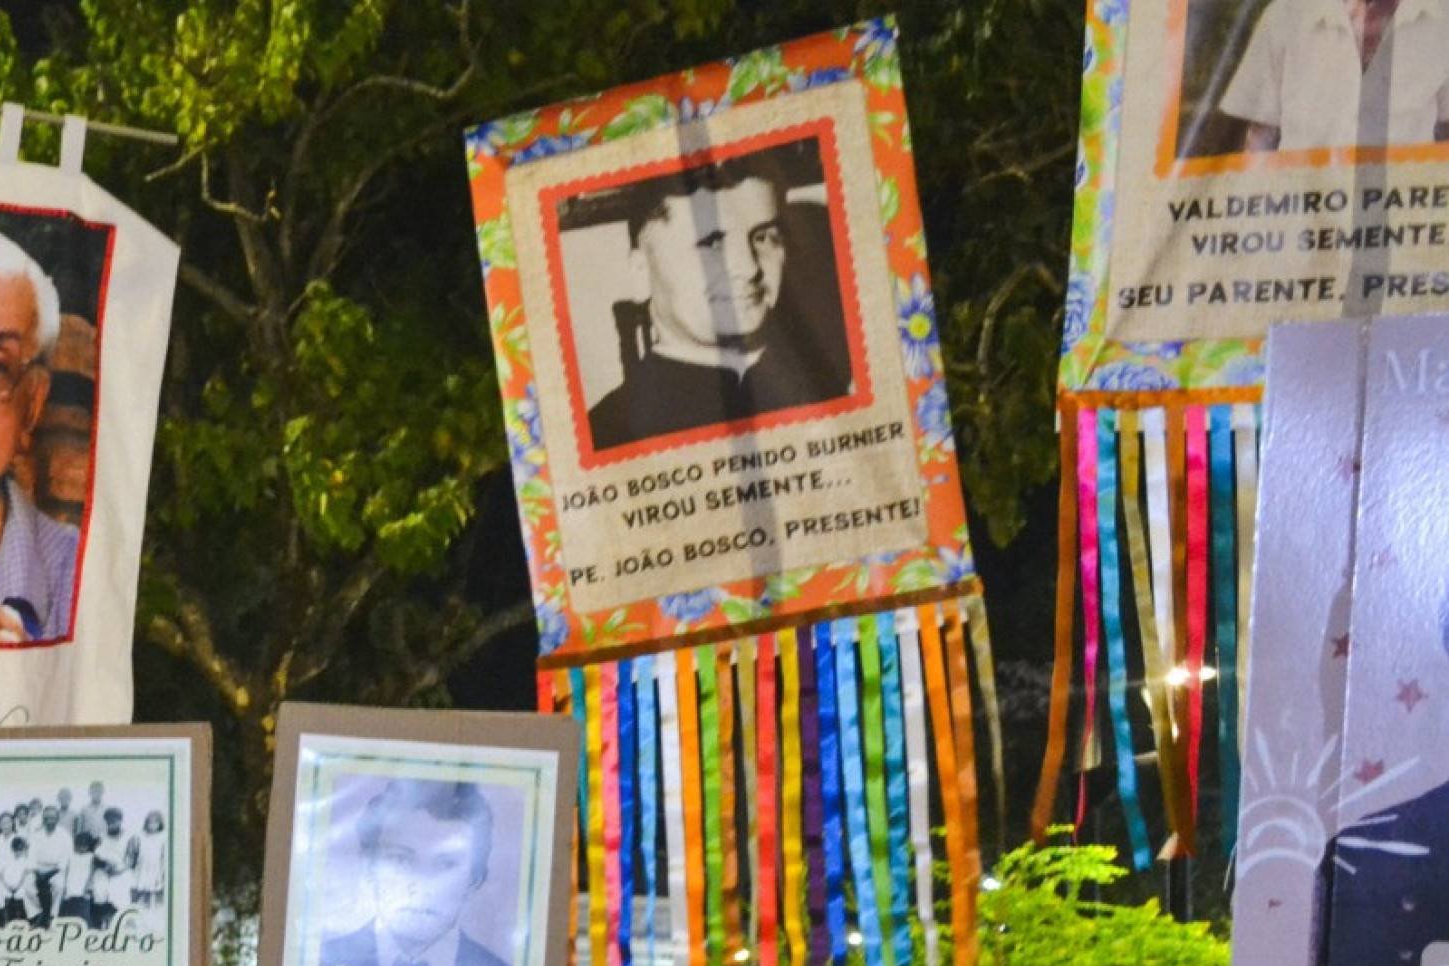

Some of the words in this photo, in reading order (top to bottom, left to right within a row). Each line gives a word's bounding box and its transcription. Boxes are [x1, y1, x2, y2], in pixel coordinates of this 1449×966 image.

[1168, 188, 1348, 222] VALDEMIRO
[1191, 231, 1284, 256] VIROU
[1298, 222, 1447, 251] SEMENTE
[1118, 284, 1175, 310] SEU
[561, 482, 619, 511] JOÃO
[627, 463, 704, 497] BOSCO
[712, 444, 797, 476] PENIDO
[807, 421, 905, 459] BURNIER
[621, 497, 696, 529] VIROU
[705, 470, 851, 511] SEMENTE...
[569, 563, 606, 587] PE.
[616, 547, 674, 577] JOÃO
[683, 525, 776, 561] BOSCO,
[785, 499, 921, 539] PRESENTE!
[50, 908, 165, 954] Pedro
